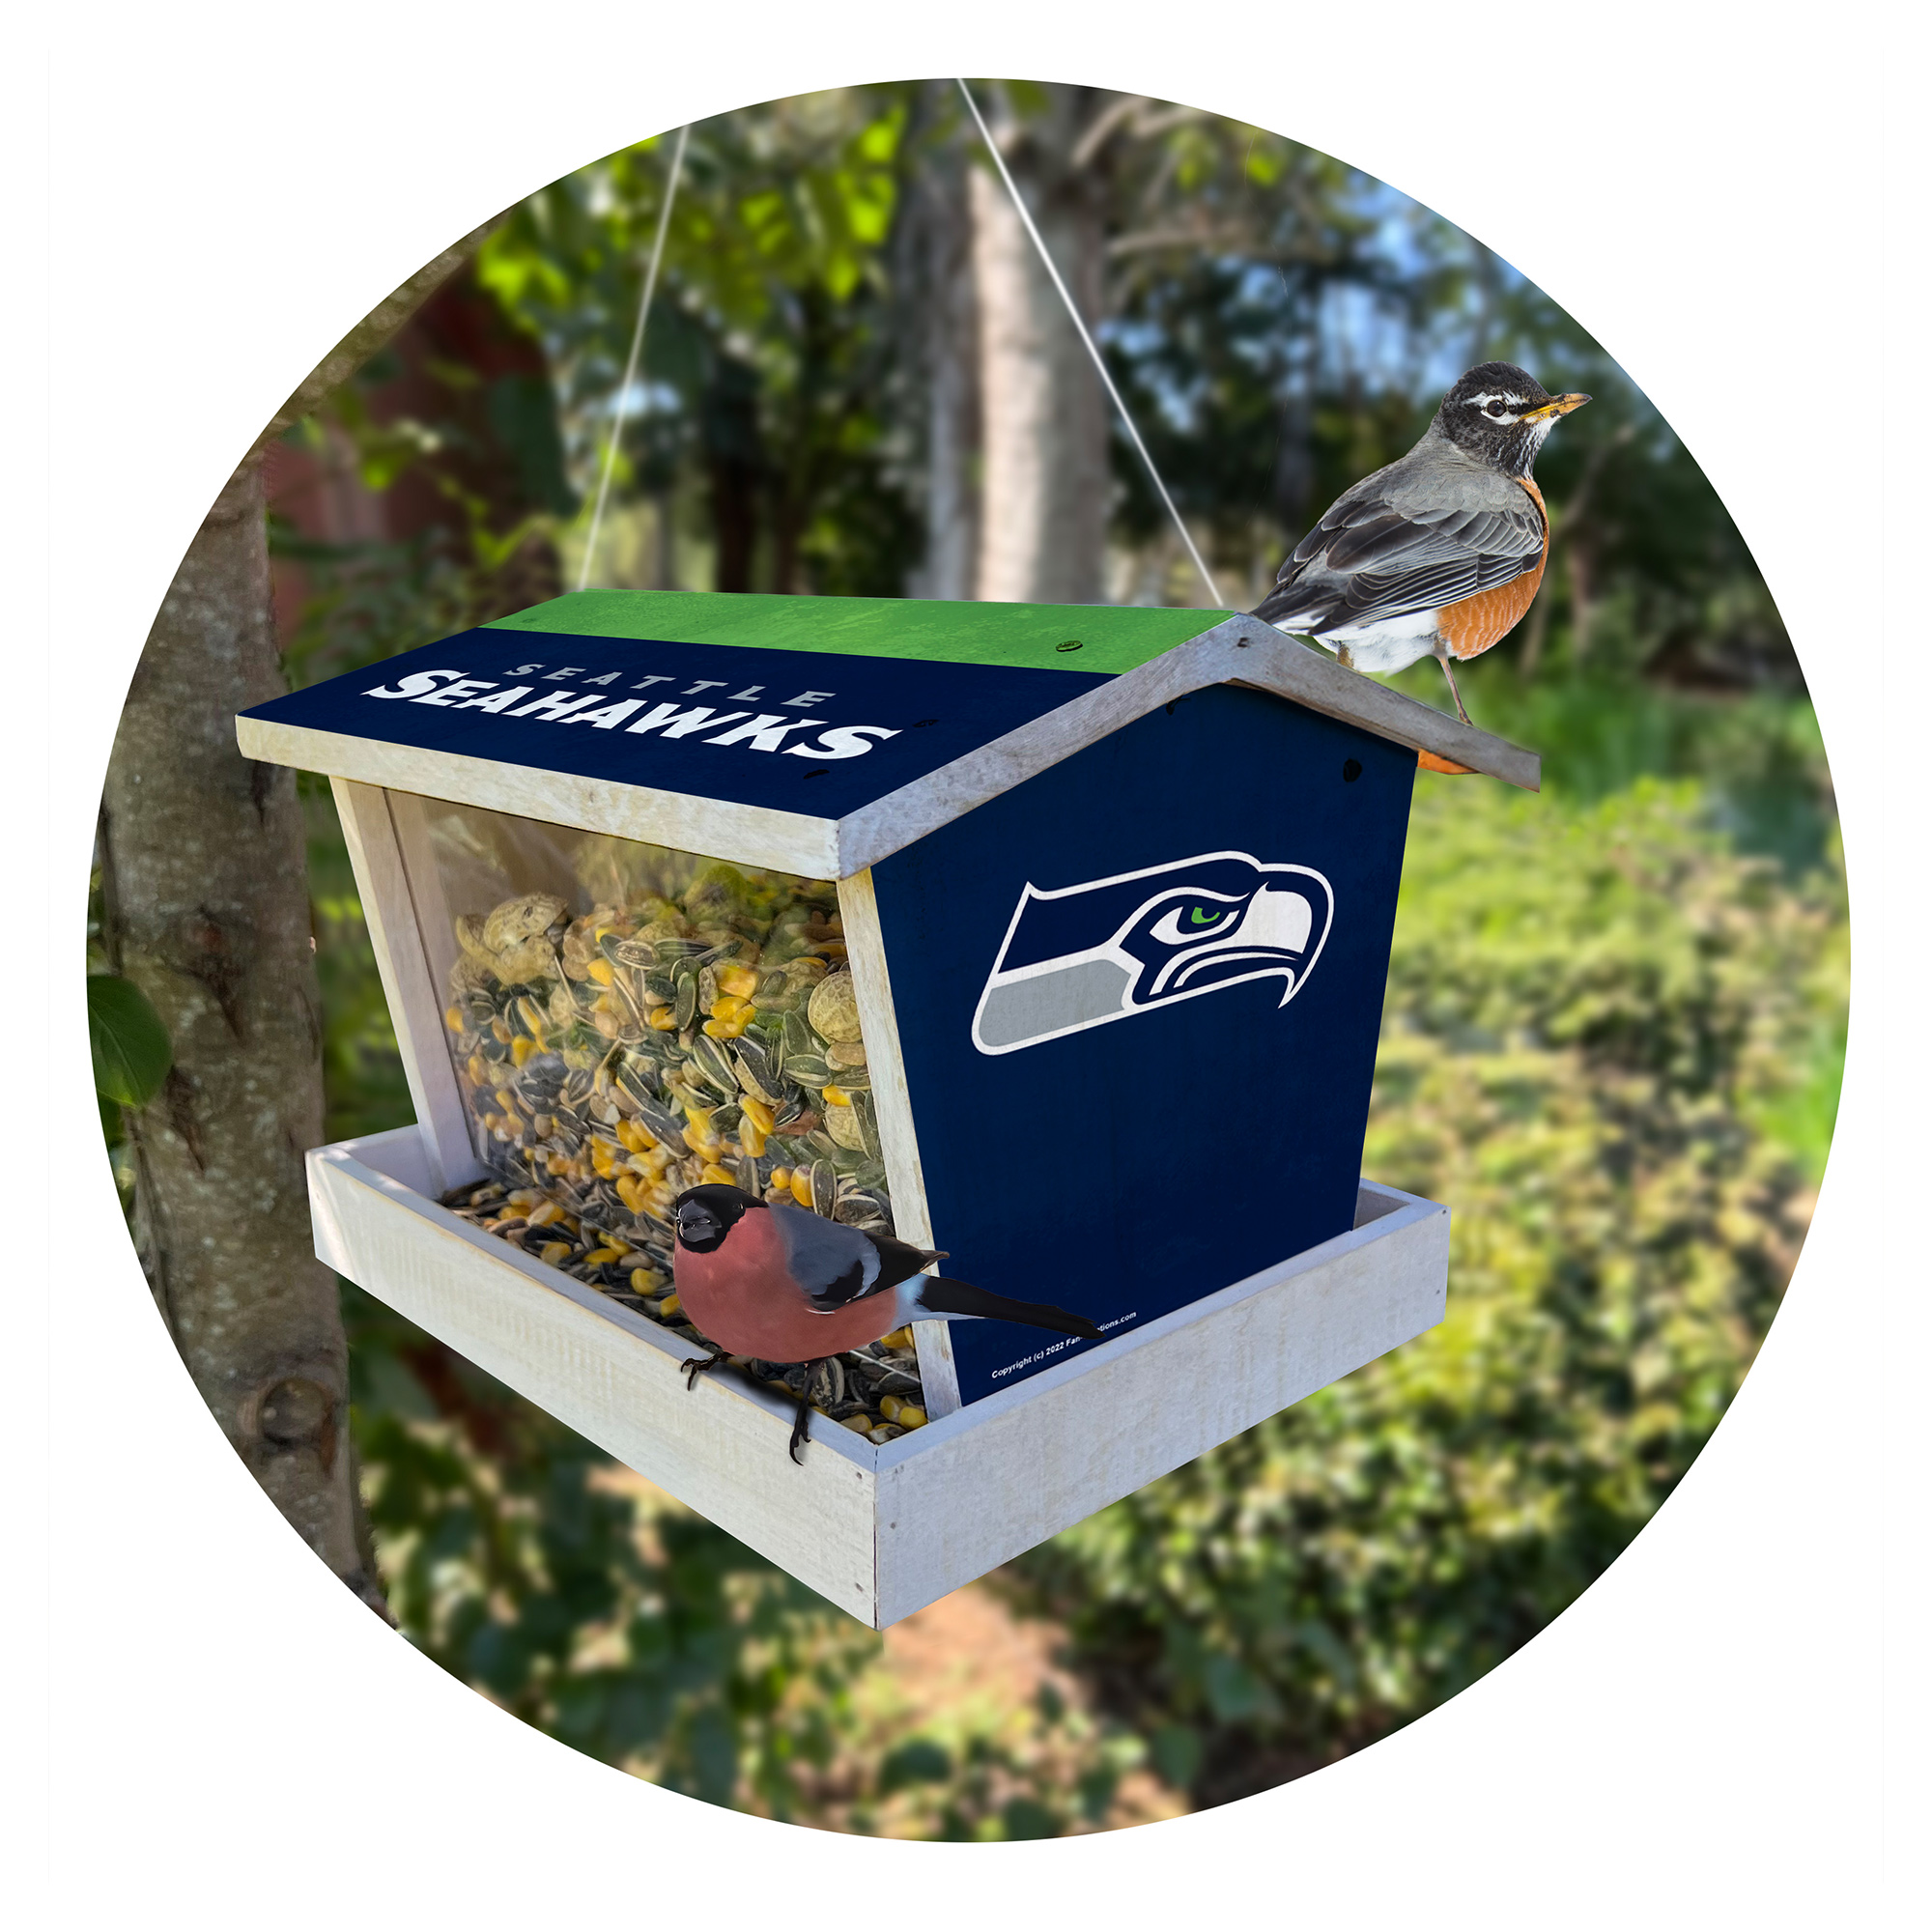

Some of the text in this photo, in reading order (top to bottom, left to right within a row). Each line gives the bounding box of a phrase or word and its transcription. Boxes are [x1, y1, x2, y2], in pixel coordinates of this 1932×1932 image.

[502, 664, 837, 708] SEATTLE
[359, 669, 903, 760] SEAHAWKS
[991, 1355, 1033, 1378] Copyright
[1033, 1350, 1044, 1363] (c)
[1045, 1341, 1065, 1356] 2022
